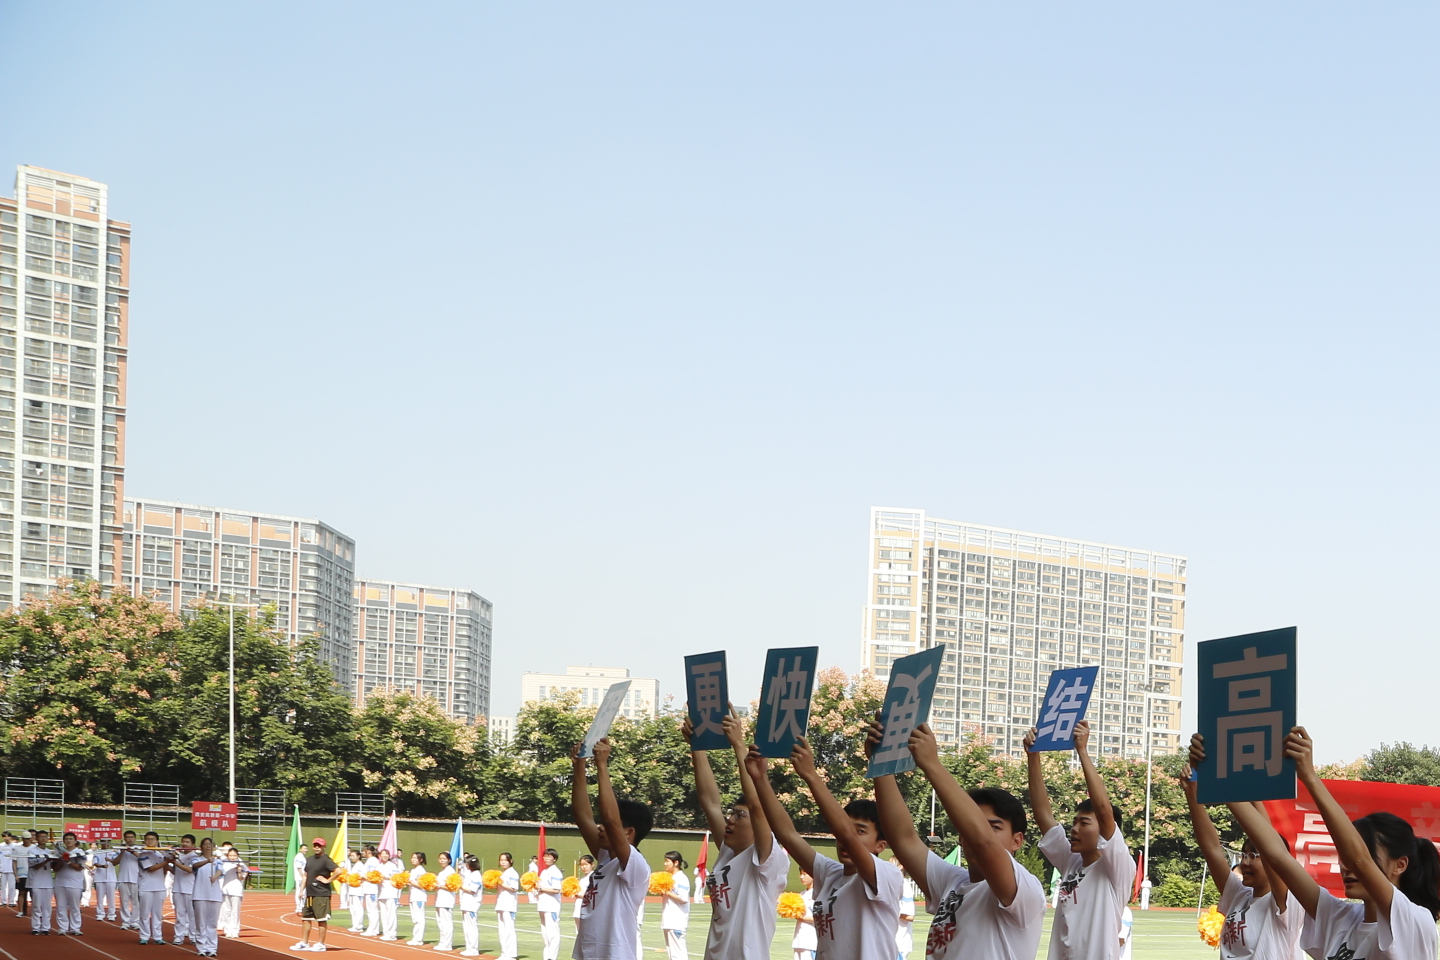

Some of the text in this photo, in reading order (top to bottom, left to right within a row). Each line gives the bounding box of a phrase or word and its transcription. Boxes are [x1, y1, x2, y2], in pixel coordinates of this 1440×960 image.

[691, 662, 724, 737] 更
[766, 656, 807, 743] 快
[1038, 676, 1088, 742] 结
[1212, 646, 1288, 779] 高
